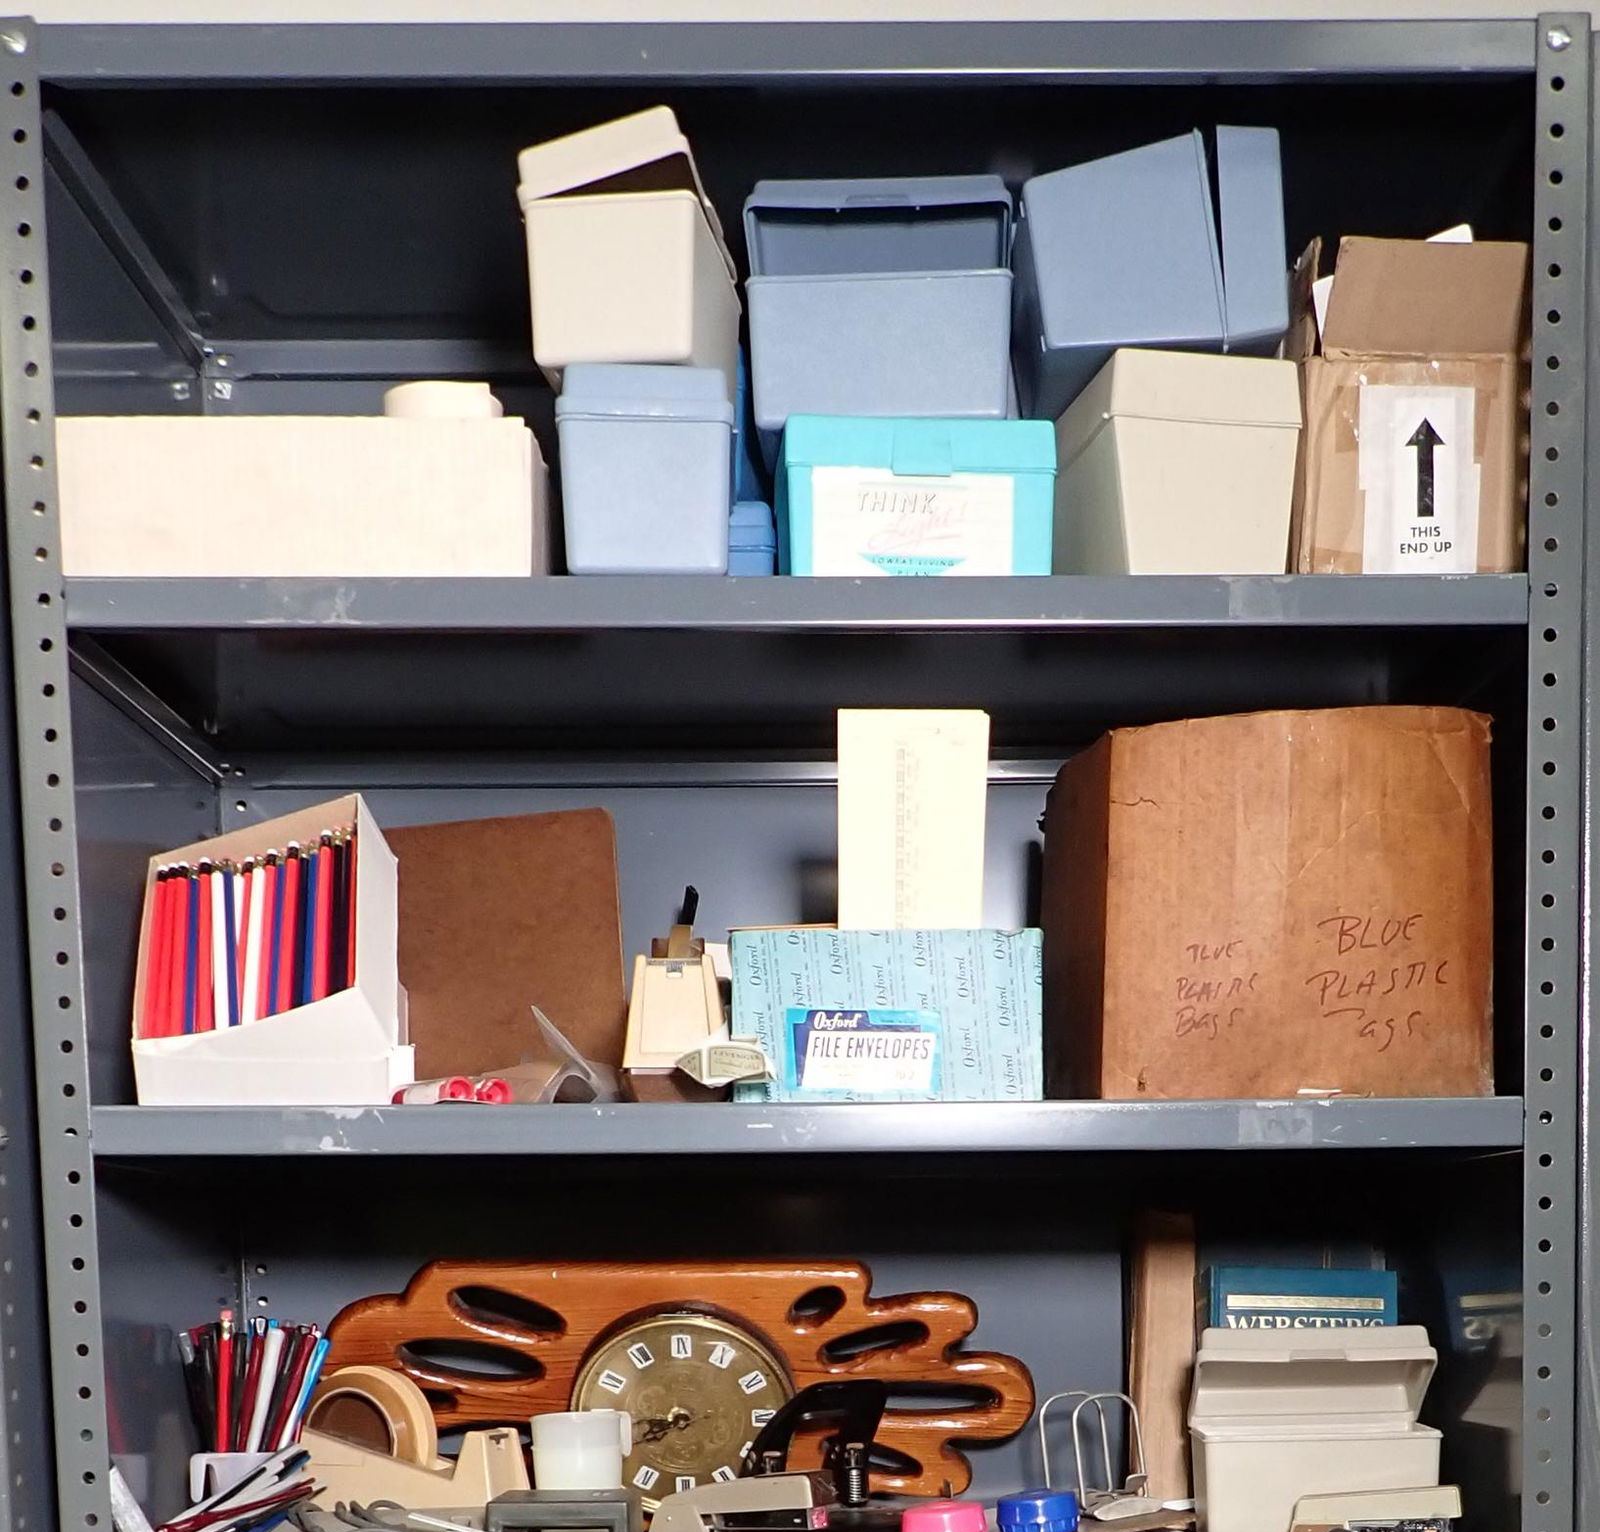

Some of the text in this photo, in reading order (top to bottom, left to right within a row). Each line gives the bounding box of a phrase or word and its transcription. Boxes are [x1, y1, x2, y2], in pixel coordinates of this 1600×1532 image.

[858, 492, 937, 514] THINK
[1400, 542, 1452, 554] END UP
[1410, 526, 1441, 537] THIS
[1317, 914, 1423, 955] BLUE
[746, 944, 762, 986] Oxford
[873, 964, 888, 1006] Oxford
[954, 957, 970, 998] Oxford
[1305, 960, 1448, 1005] PLASTIC
[814, 1010, 859, 1030] Oxford
[996, 986, 1011, 1027] Oxford
[812, 1036, 931, 1060] FILE ENVELOPES
[960, 1027, 975, 1068] Oxford
[1002, 1054, 1017, 1095] Oxford
[676, 1337, 689, 1355] IX
